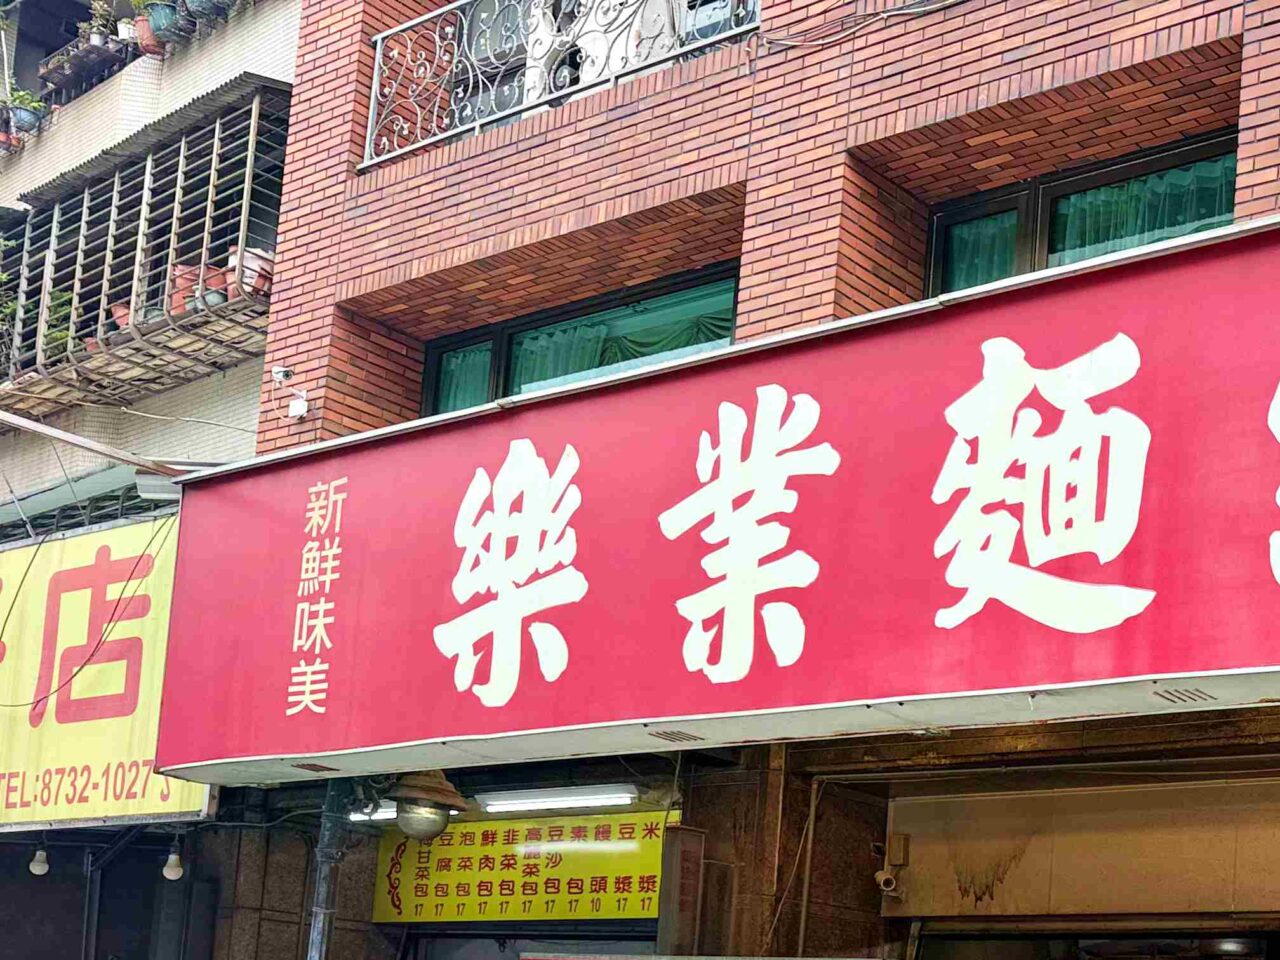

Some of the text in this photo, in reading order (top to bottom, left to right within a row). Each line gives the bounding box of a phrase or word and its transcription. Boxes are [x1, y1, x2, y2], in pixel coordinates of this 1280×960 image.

[285, 476, 348, 718] 新鮮味美
[28, 544, 155, 728] 店
[414, 903, 423, 916] 17
[435, 903, 444, 916] 17
[456, 903, 466, 916] 17
[478, 902, 488, 915] 17
[499, 901, 510, 914] 17
[522, 900, 533, 914] 17
[545, 900, 555, 913] 17
[568, 899, 579, 913] 17
[591, 897, 601, 912] 10
[616, 897, 627, 912] 17
[641, 897, 652, 912] 17
